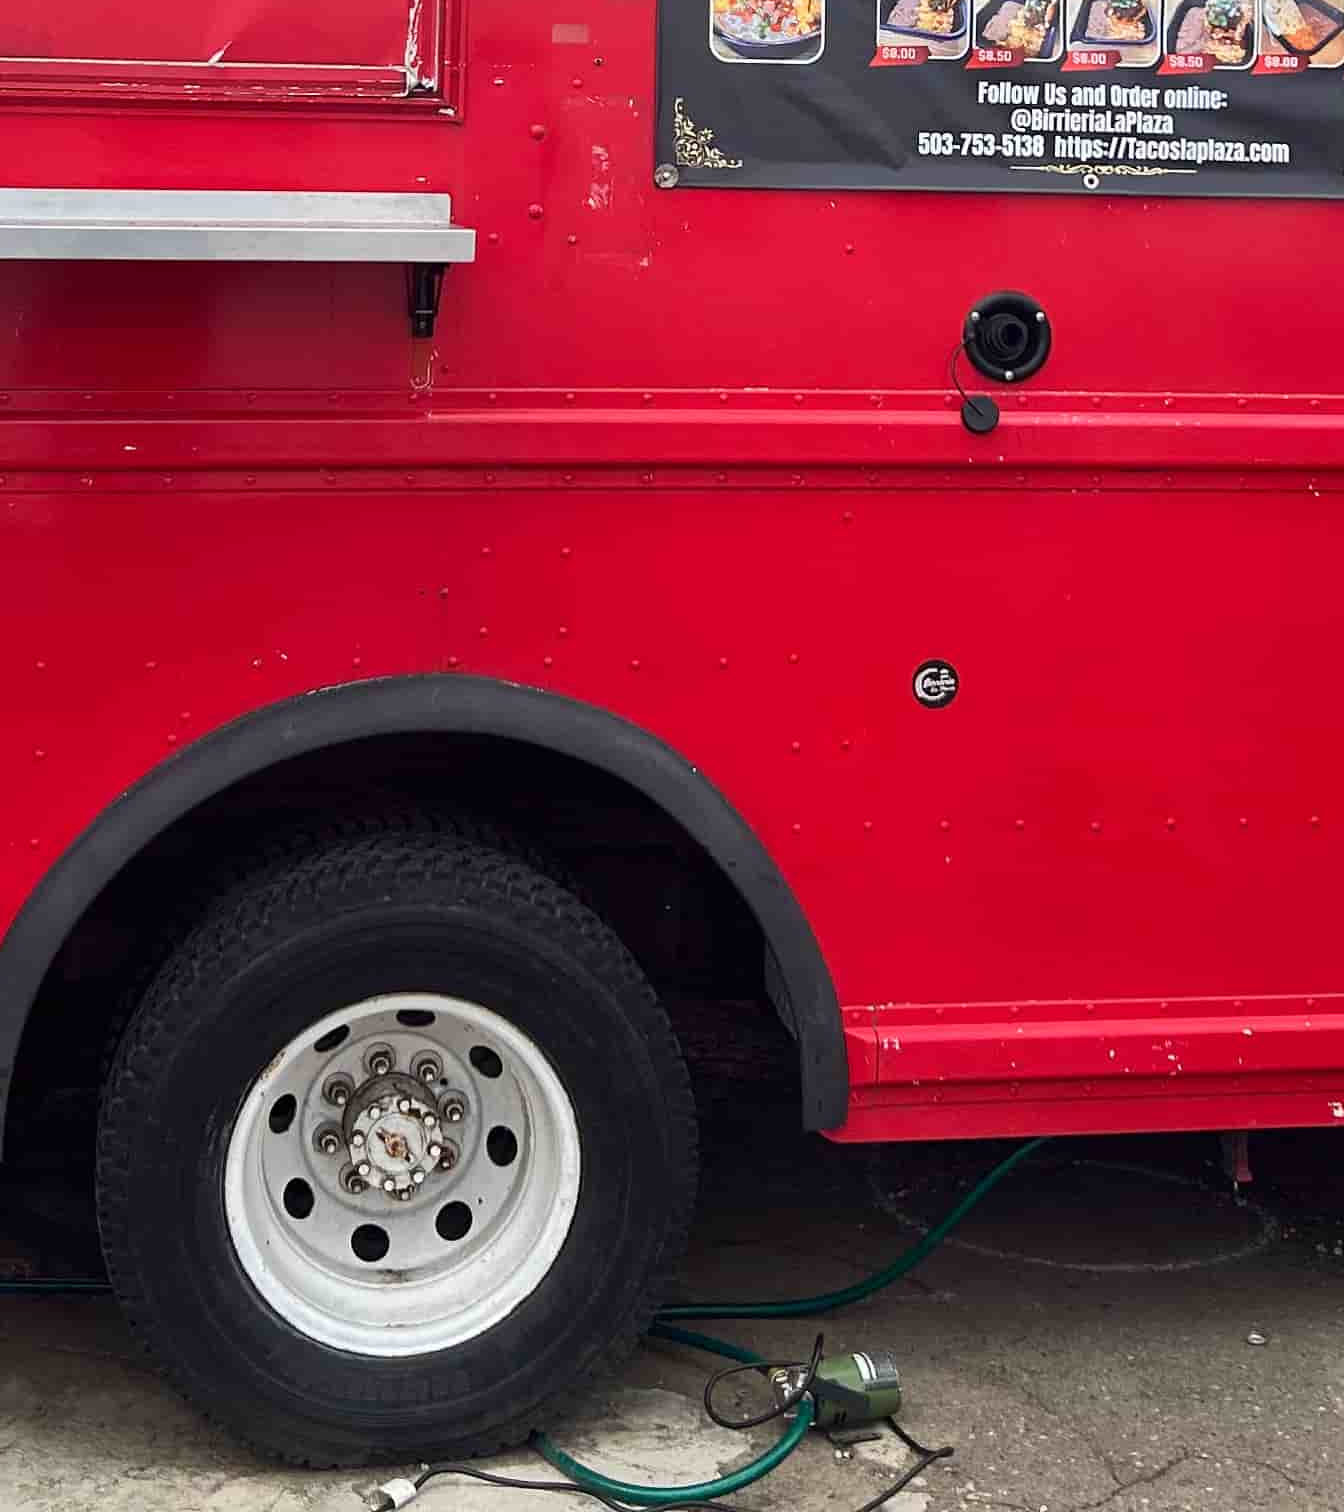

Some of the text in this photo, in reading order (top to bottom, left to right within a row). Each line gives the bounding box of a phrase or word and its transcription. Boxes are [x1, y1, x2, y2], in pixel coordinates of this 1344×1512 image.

[978, 82, 1228, 110] Follow Us and Order online:
[1011, 109, 1174, 134] @BirrieriaLaPlaza
[918, 132, 1290, 164] 503-753-5138 https://Tacoslaplaza.com
